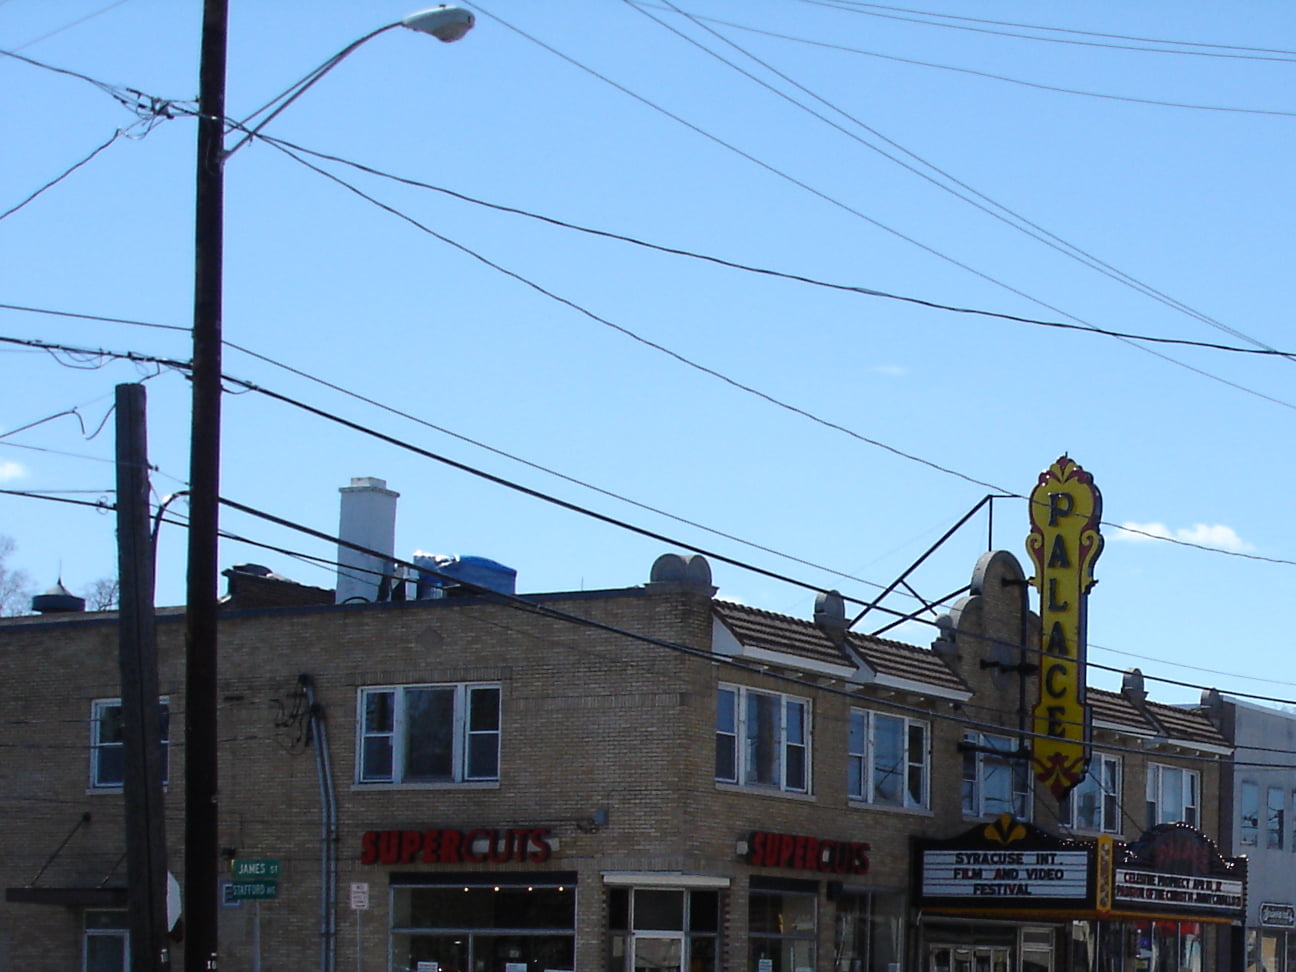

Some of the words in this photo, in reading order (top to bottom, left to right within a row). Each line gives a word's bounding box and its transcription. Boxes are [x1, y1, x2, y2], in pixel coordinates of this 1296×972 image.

[1045, 491, 1075, 740] PALACE
[360, 828, 552, 865] SUPERCUTS
[954, 852, 1024, 865] SYRACUSE
[1036, 852, 1064, 865] INT.
[238, 863, 265, 874] JAMES
[953, 868, 983, 880] FILM
[993, 868, 1019, 880] AND
[1026, 868, 1065, 881] VIDEO
[233, 884, 265, 895] STAFFORD
[973, 883, 1032, 896] FESTIVAL
